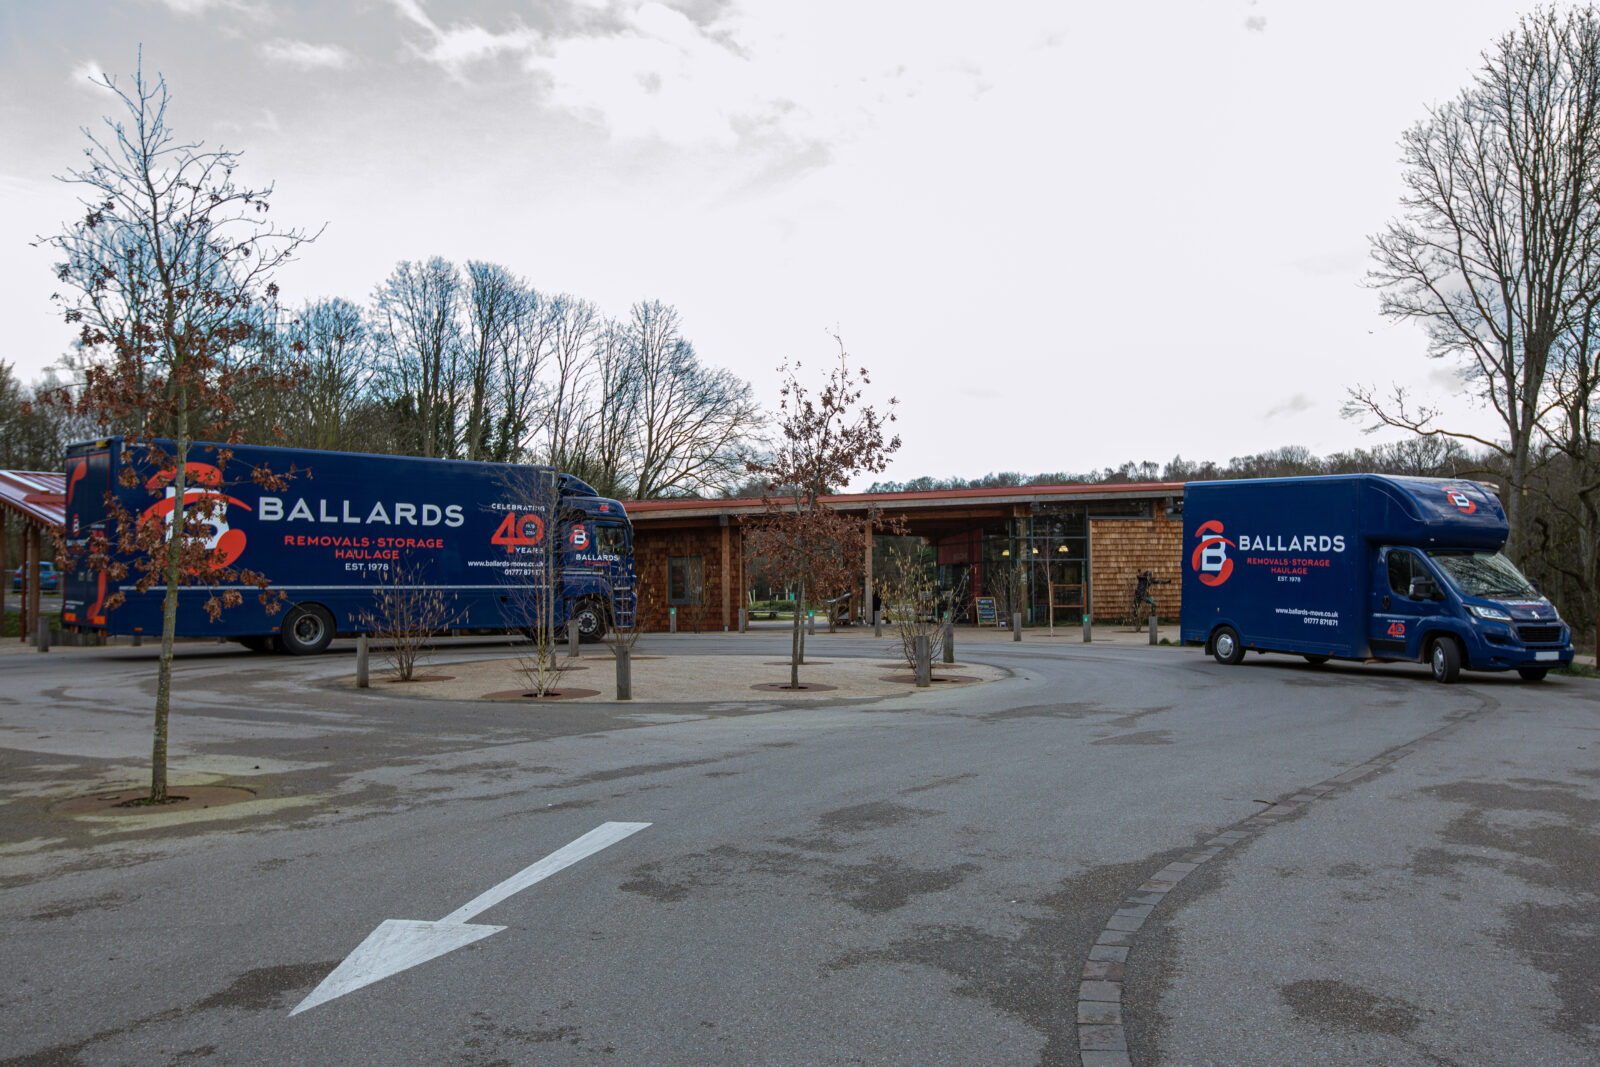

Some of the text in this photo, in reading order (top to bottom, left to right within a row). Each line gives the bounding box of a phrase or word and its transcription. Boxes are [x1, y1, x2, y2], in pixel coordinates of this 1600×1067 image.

[258, 496, 465, 528] BALLARDS
[491, 512, 545, 554] 40
[573, 529, 586, 544] B
[284, 535, 444, 549] REMOVALS STORAGE
[1239, 535, 1346, 553] BALLARDS
[335, 549, 400, 560] HAULAGE
[575, 553, 619, 562] BALLARDS
[1201, 535, 1227, 571] B
[345, 563, 389, 571] EST. 1978
[1247, 557, 1330, 567] REMOVALS STORAGE
[1271, 567, 1308, 575] HAULAGE
[1275, 607, 1339, 618] www.ballards-move.co.uk
[1303, 617, 1338, 627] 01777 871871
[1387, 622, 1406, 638] 40
